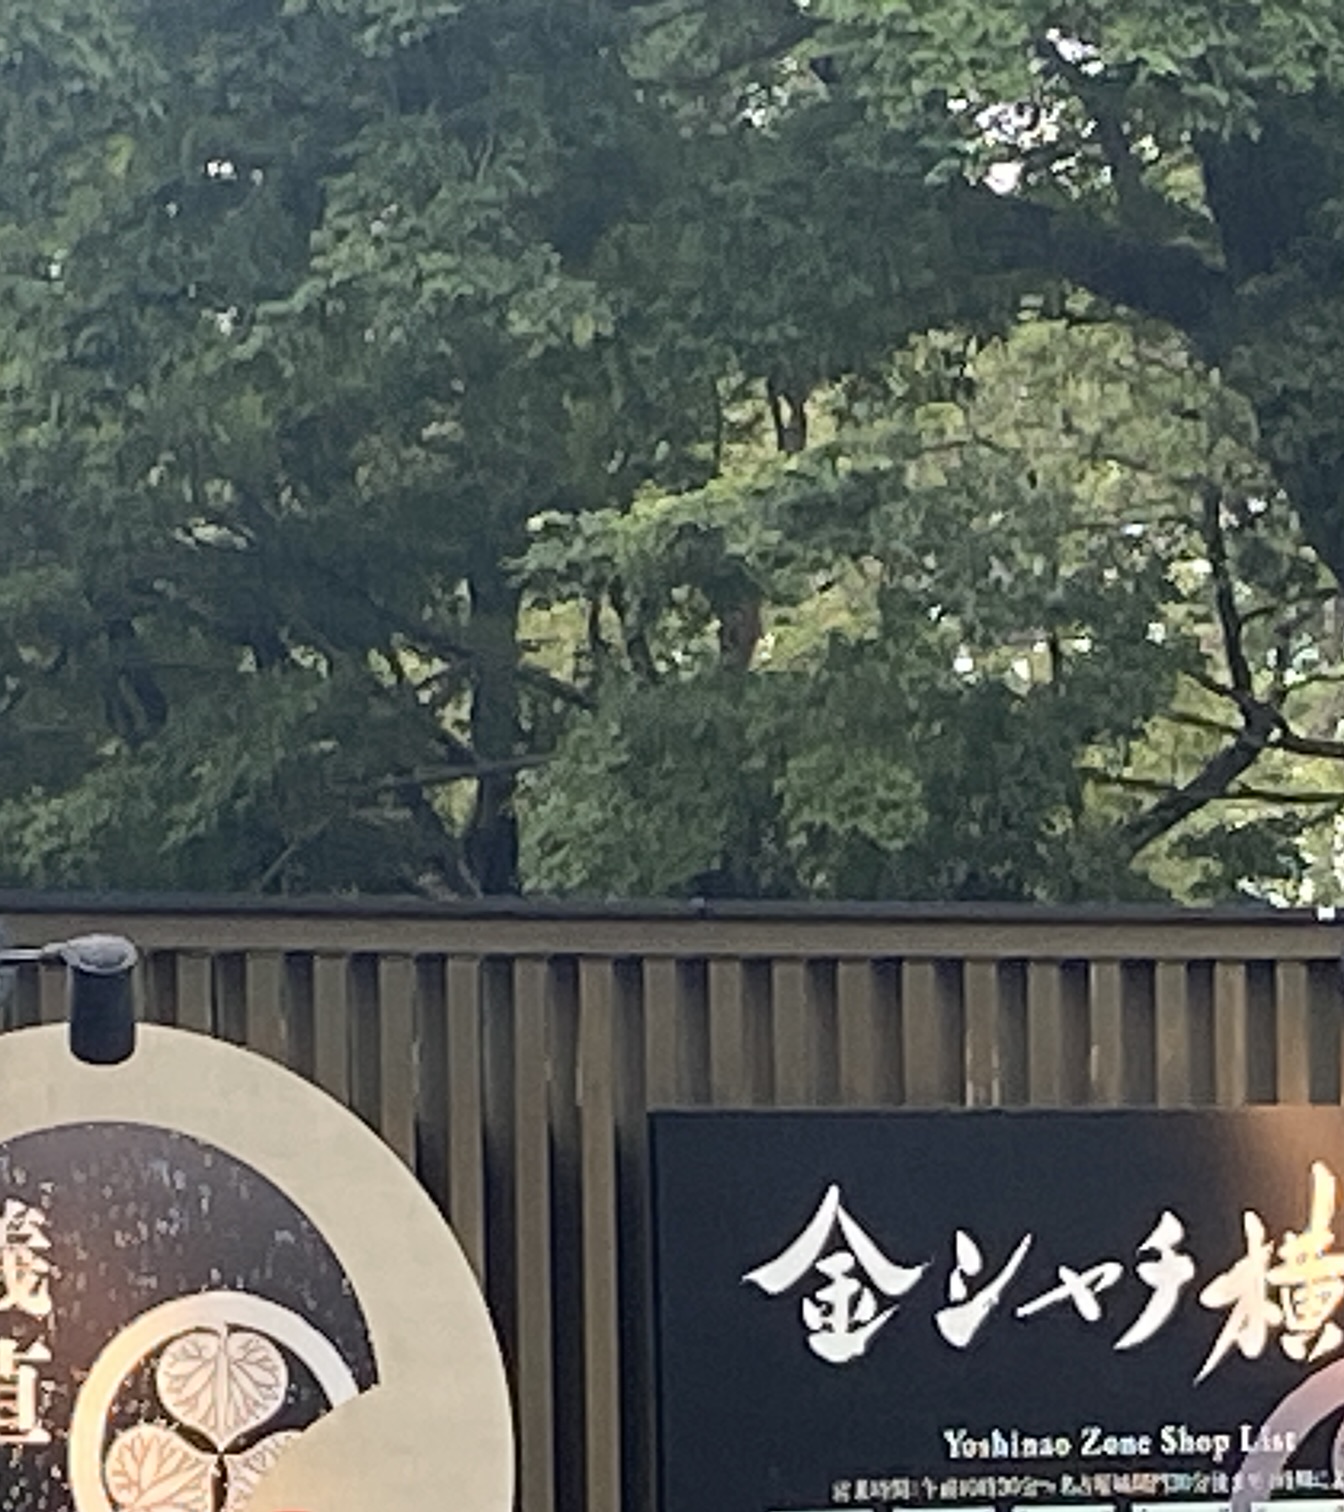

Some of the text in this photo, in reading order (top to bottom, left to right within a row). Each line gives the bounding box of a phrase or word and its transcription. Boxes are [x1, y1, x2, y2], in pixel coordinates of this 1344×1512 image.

[942, 1424, 1298, 1462] Yoshinao Zone Shop List
